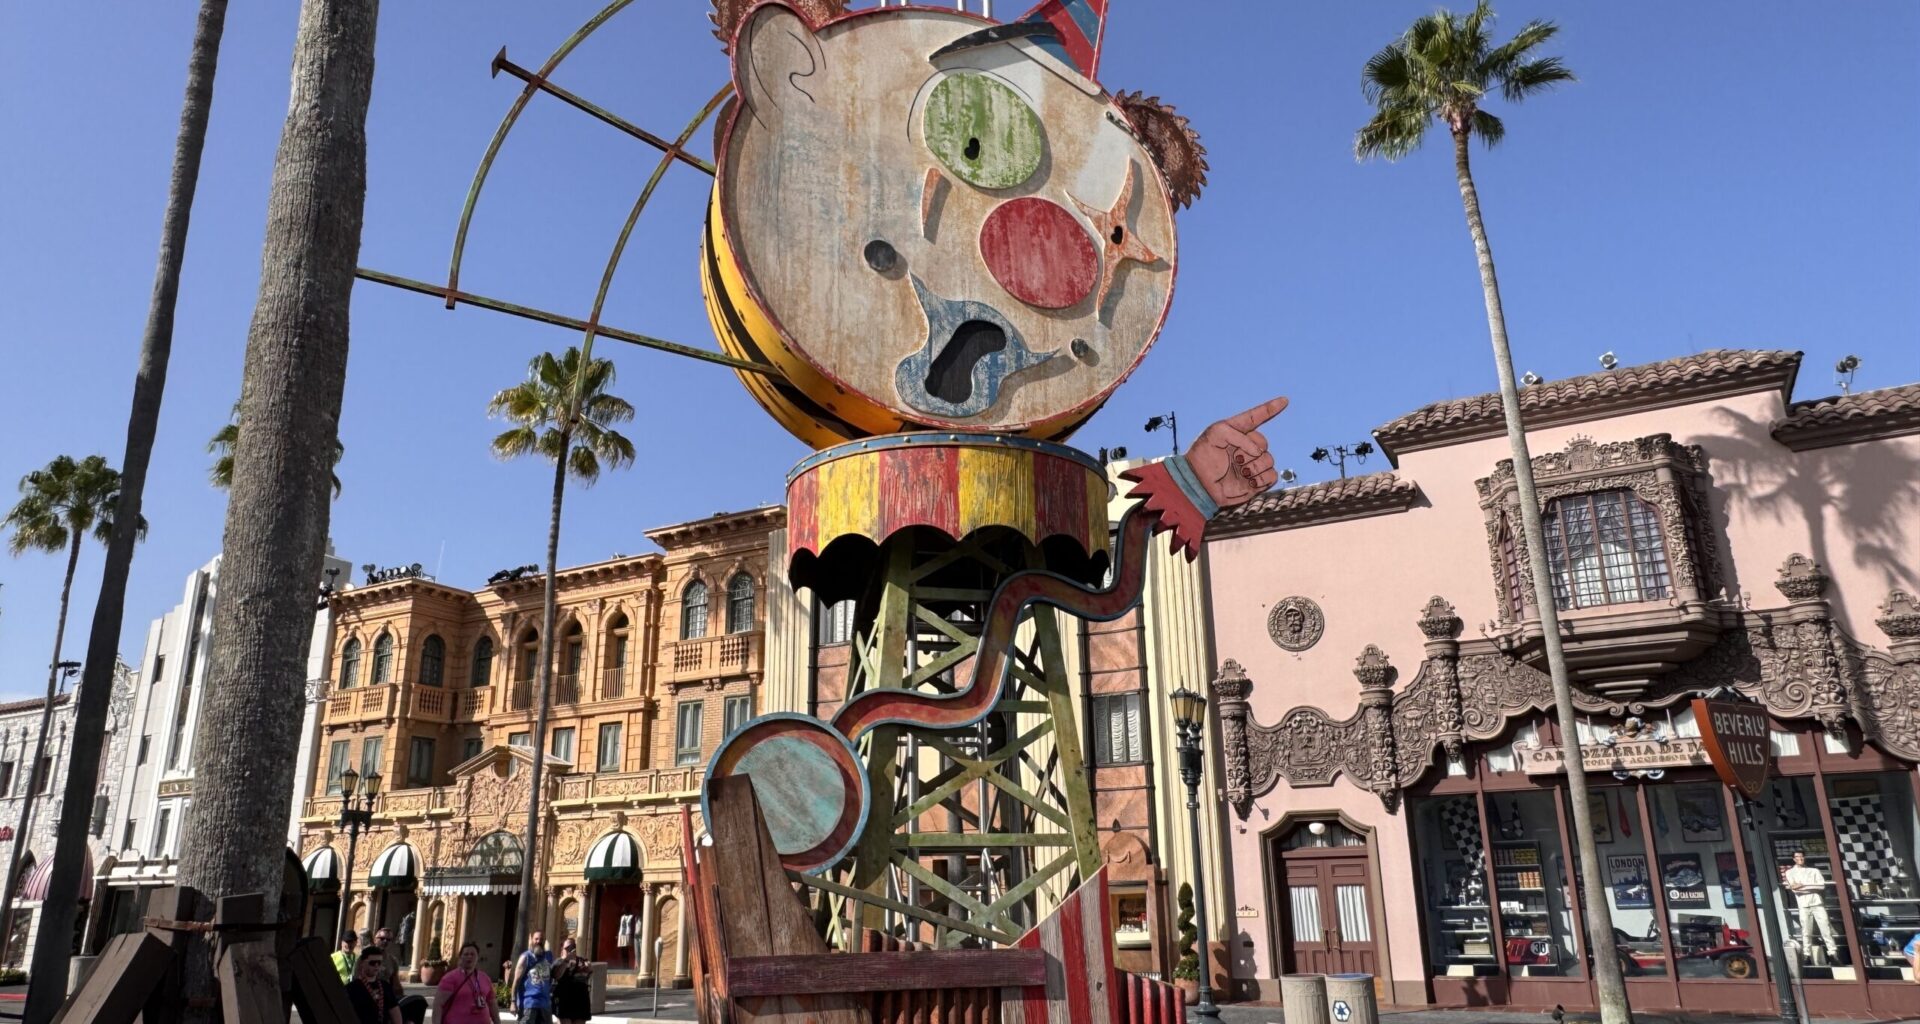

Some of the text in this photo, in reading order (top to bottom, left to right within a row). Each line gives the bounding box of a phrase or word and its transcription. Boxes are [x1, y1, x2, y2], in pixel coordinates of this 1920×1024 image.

[1713, 711, 1765, 737] BEVERLY
[1659, 742, 1683, 754] DE
[1727, 741, 1764, 765] HILLS
[1610, 857, 1645, 868] LONDON
[1534, 942, 1546, 953] 30
